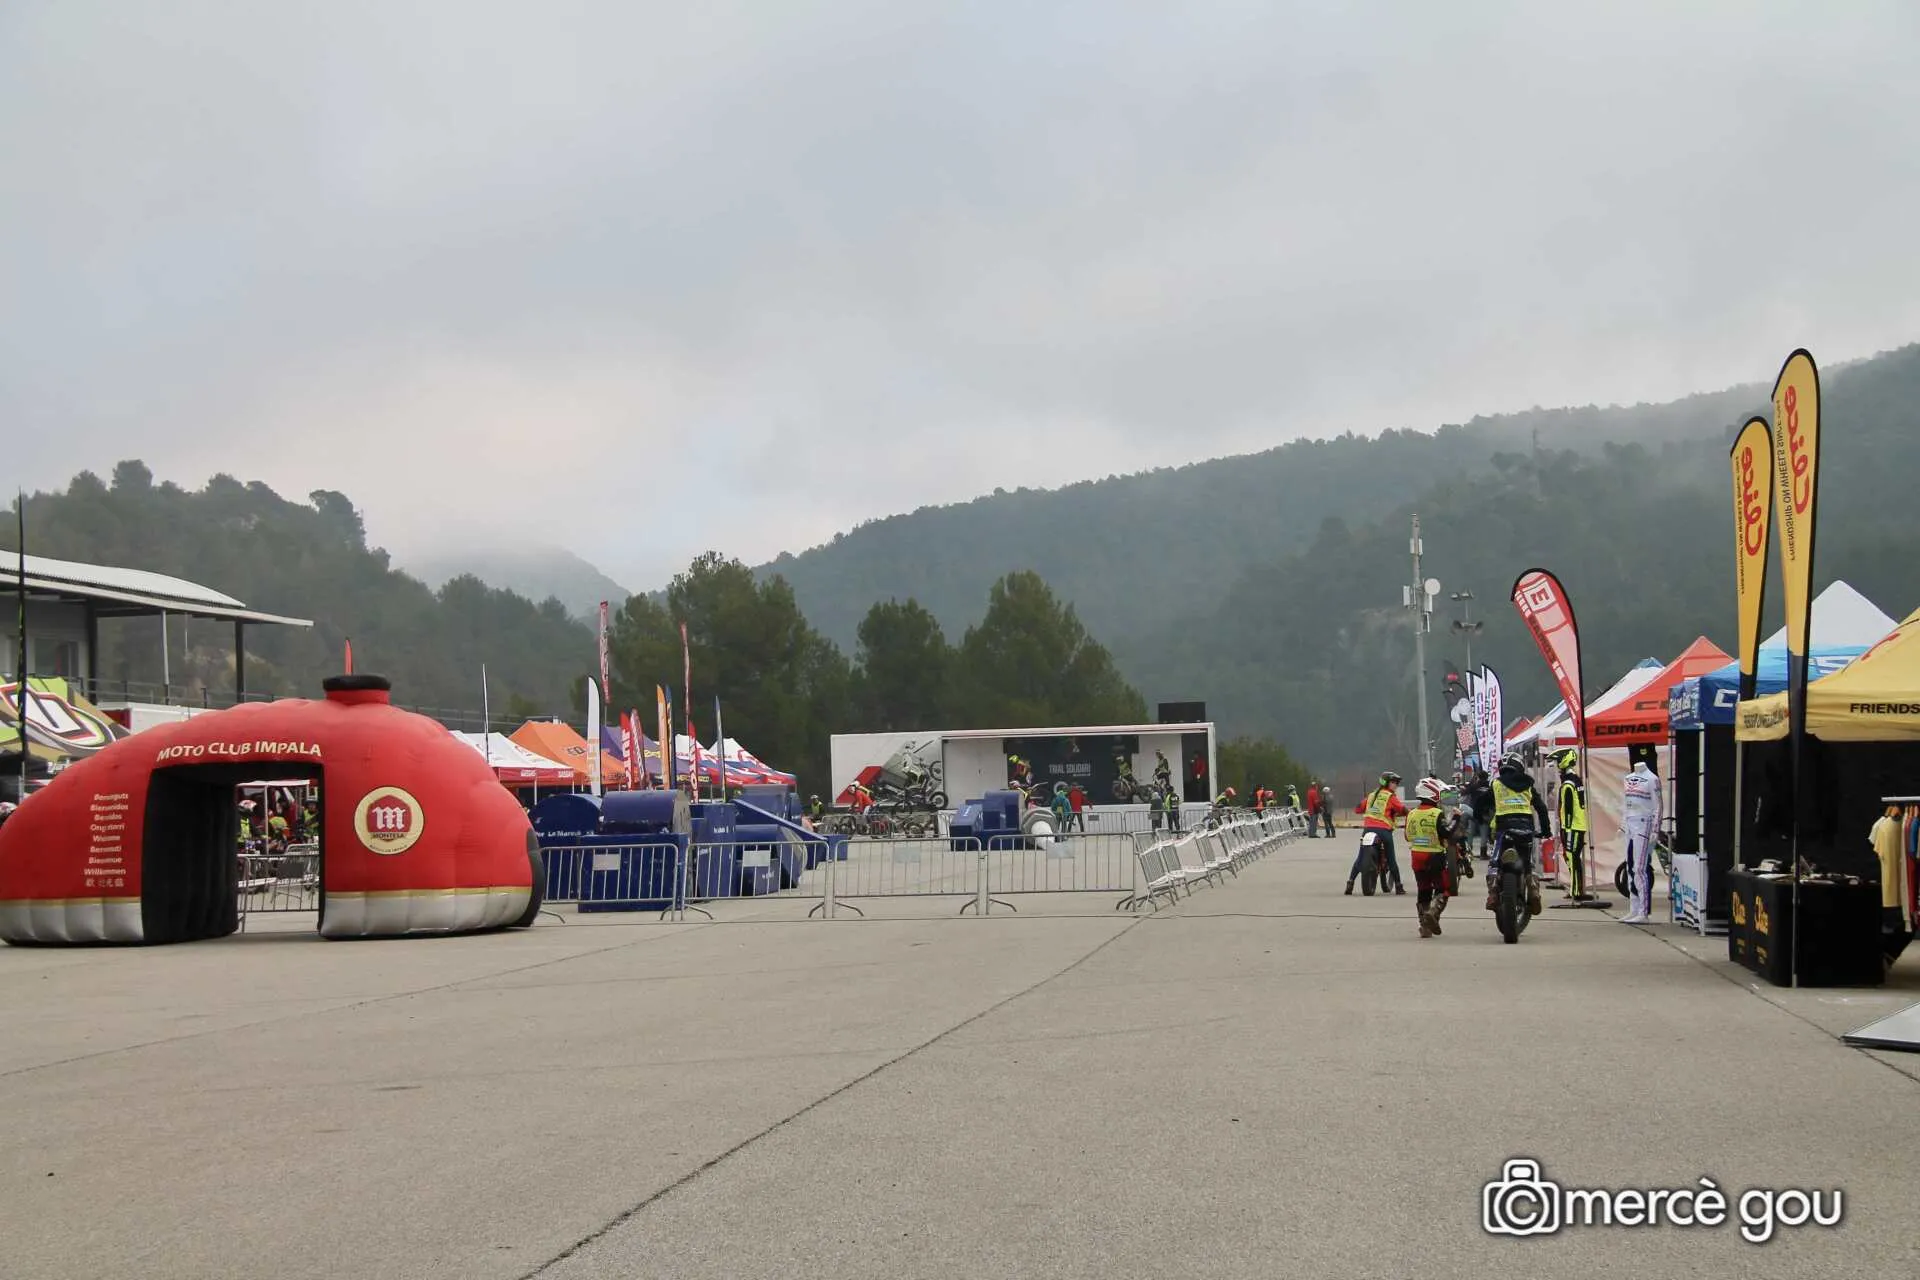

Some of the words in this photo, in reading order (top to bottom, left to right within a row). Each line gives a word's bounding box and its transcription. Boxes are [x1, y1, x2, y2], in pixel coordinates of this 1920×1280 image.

[1595, 723, 1663, 736] COMAS
[156, 745, 204, 762] MOTO
[208, 742, 252, 756] CLUB
[255, 741, 322, 757] IMPALA
